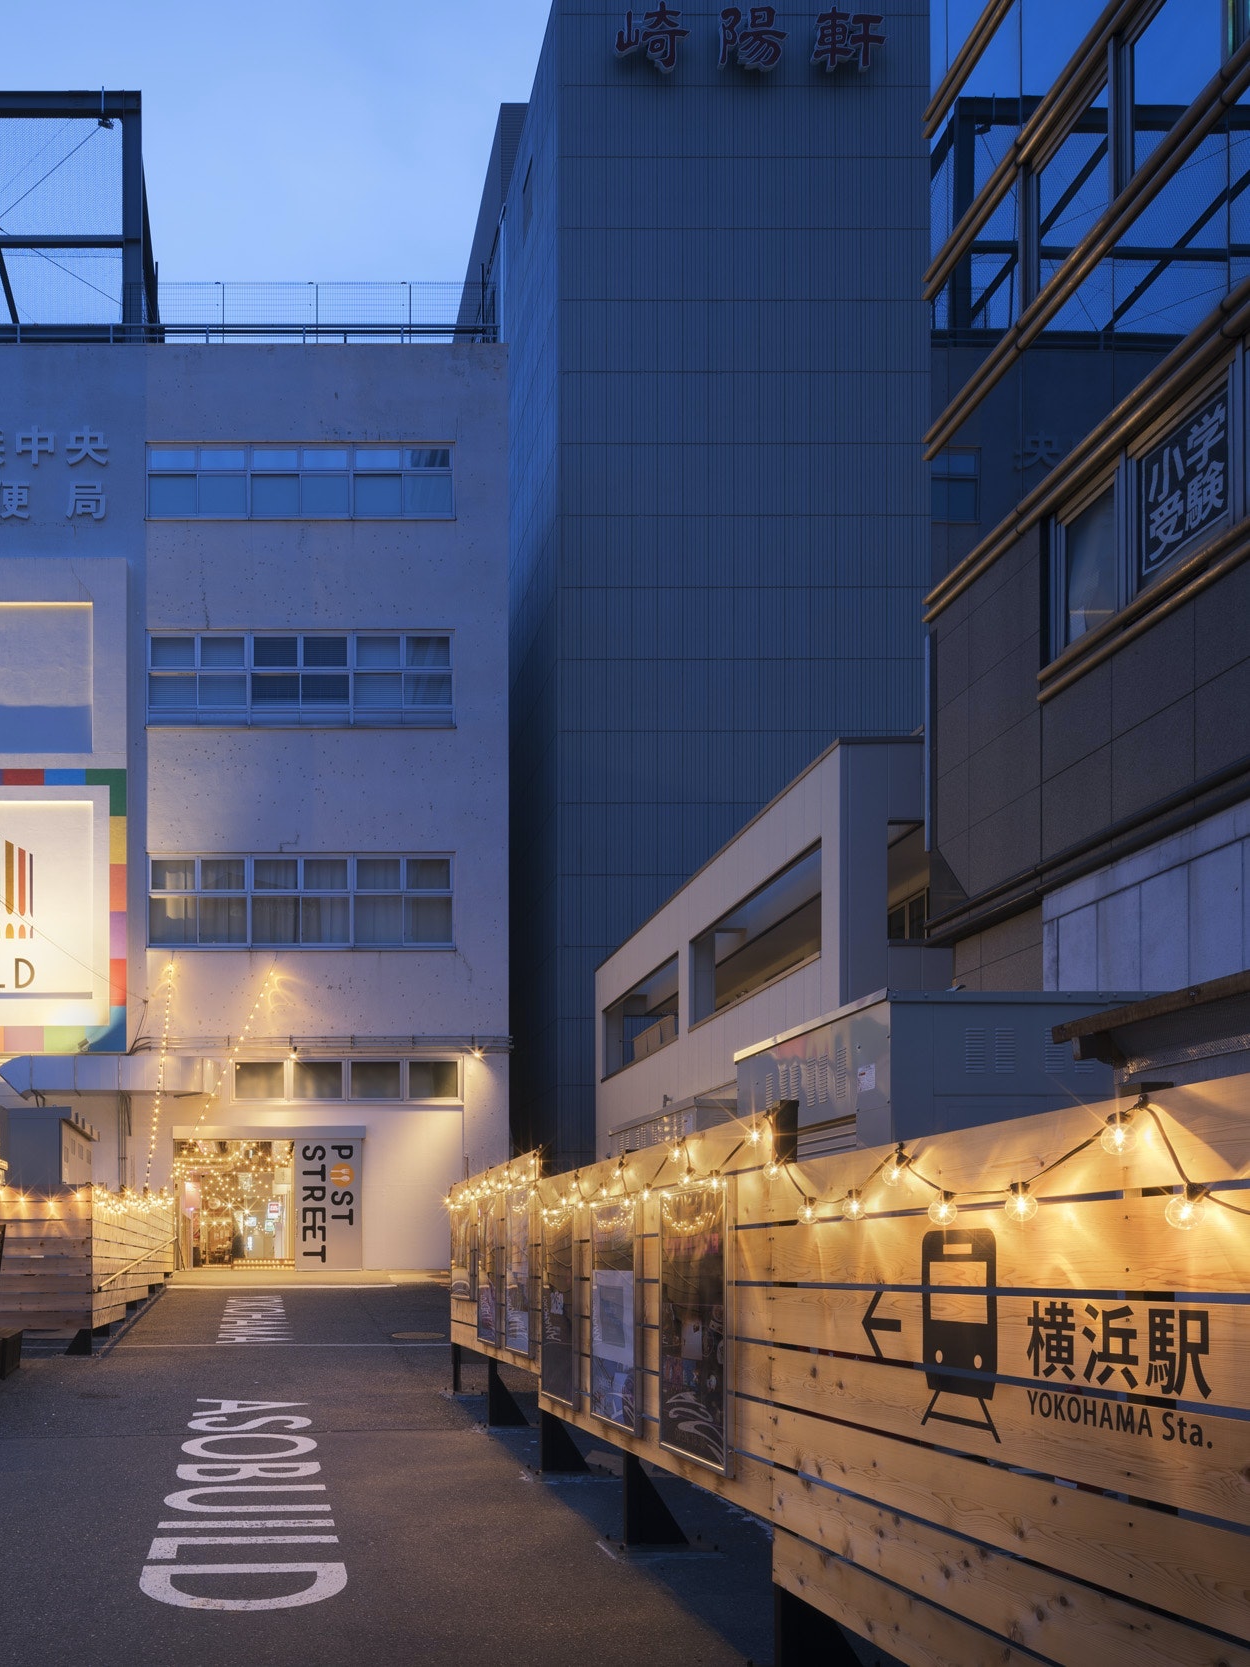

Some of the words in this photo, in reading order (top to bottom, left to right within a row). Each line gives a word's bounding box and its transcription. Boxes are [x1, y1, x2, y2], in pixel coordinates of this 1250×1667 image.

[615, 1, 886, 73] 崎陽軒
[302, 1145, 326, 1263] STREET
[216, 1295, 294, 1343] YOKOHAMA
[1027, 1301, 1212, 1399] 横浜駅
[1027, 1390, 1153, 1437] YOKOHAMA
[1162, 1411, 1213, 1449] Sta.
[139, 1398, 348, 1611] ASOBUILD
